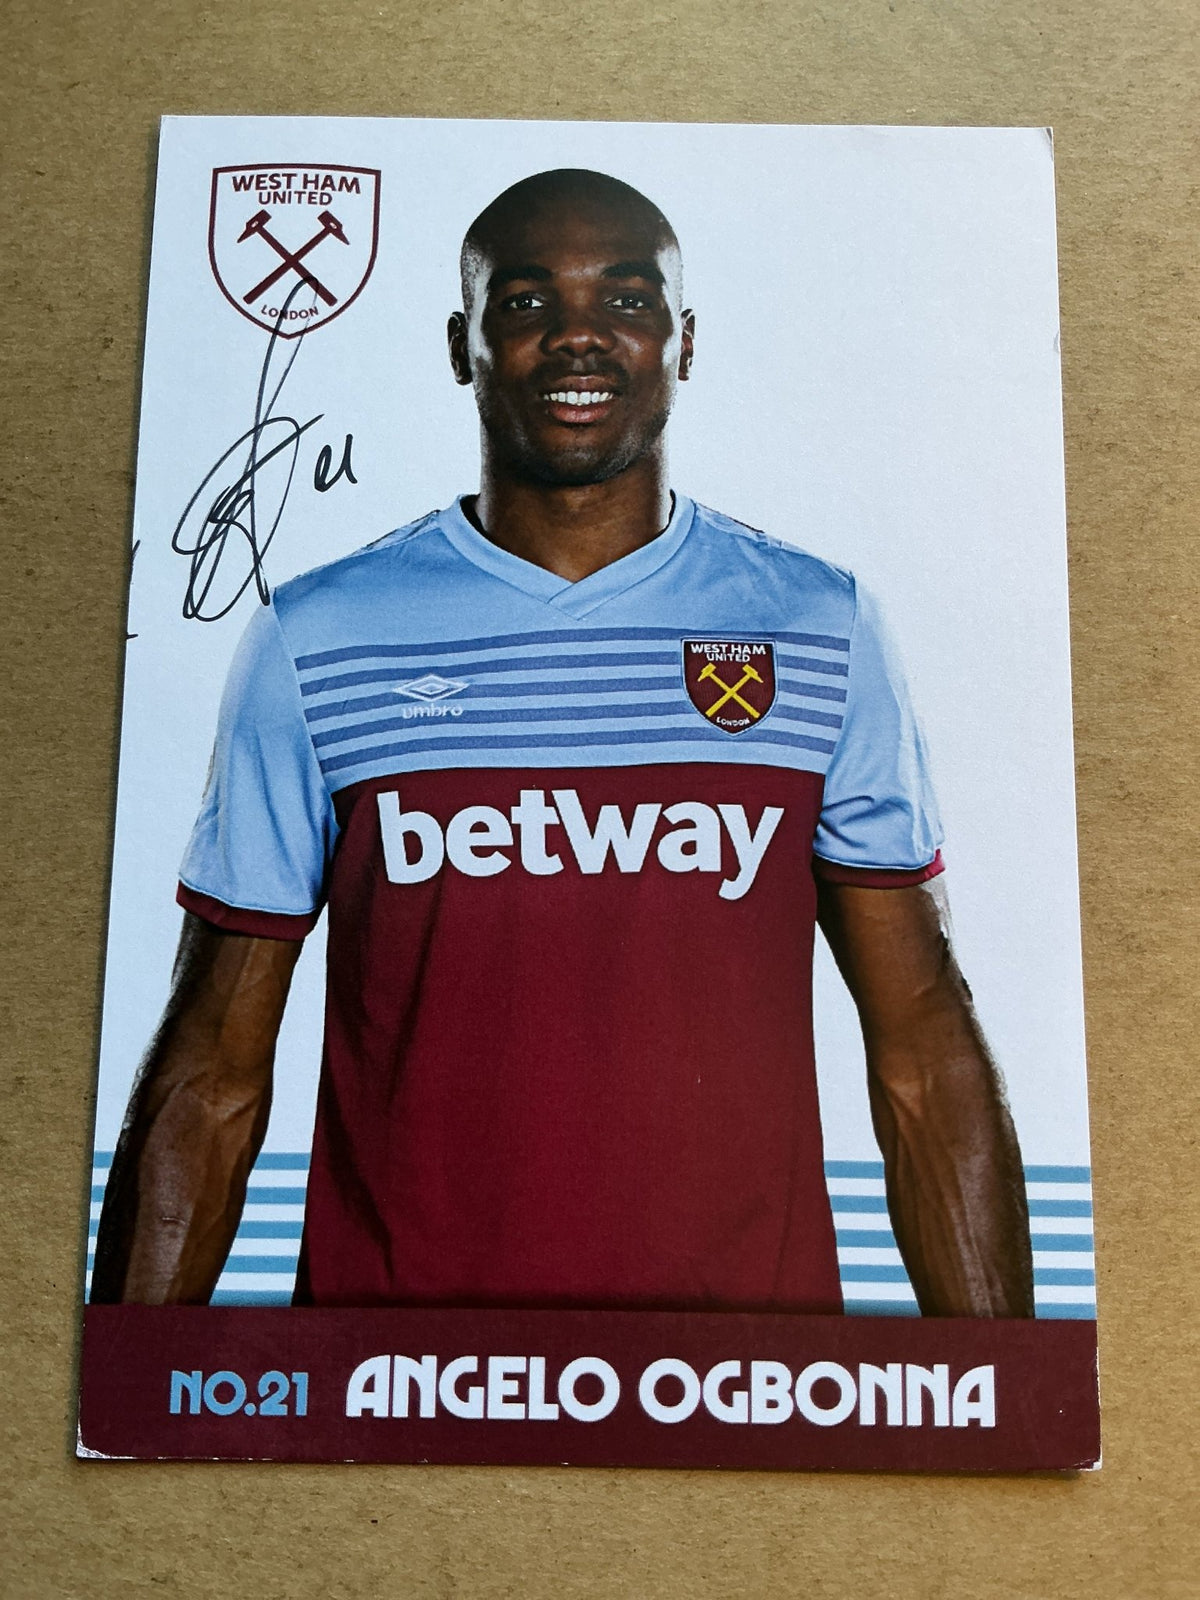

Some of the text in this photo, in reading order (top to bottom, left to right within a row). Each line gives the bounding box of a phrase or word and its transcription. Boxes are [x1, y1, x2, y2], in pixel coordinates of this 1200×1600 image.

[232, 173, 361, 194] WEST HAM
[258, 190, 332, 206] UNITED
[261, 304, 319, 321] LONDON
[690, 643, 767, 655] WEST HAM
[706, 653, 751, 663] UNITED
[402, 702, 463, 720] umbro
[377, 789, 785, 901] betway
[169, 1354, 996, 1428] NO.21 ANGELO OGBONNA
